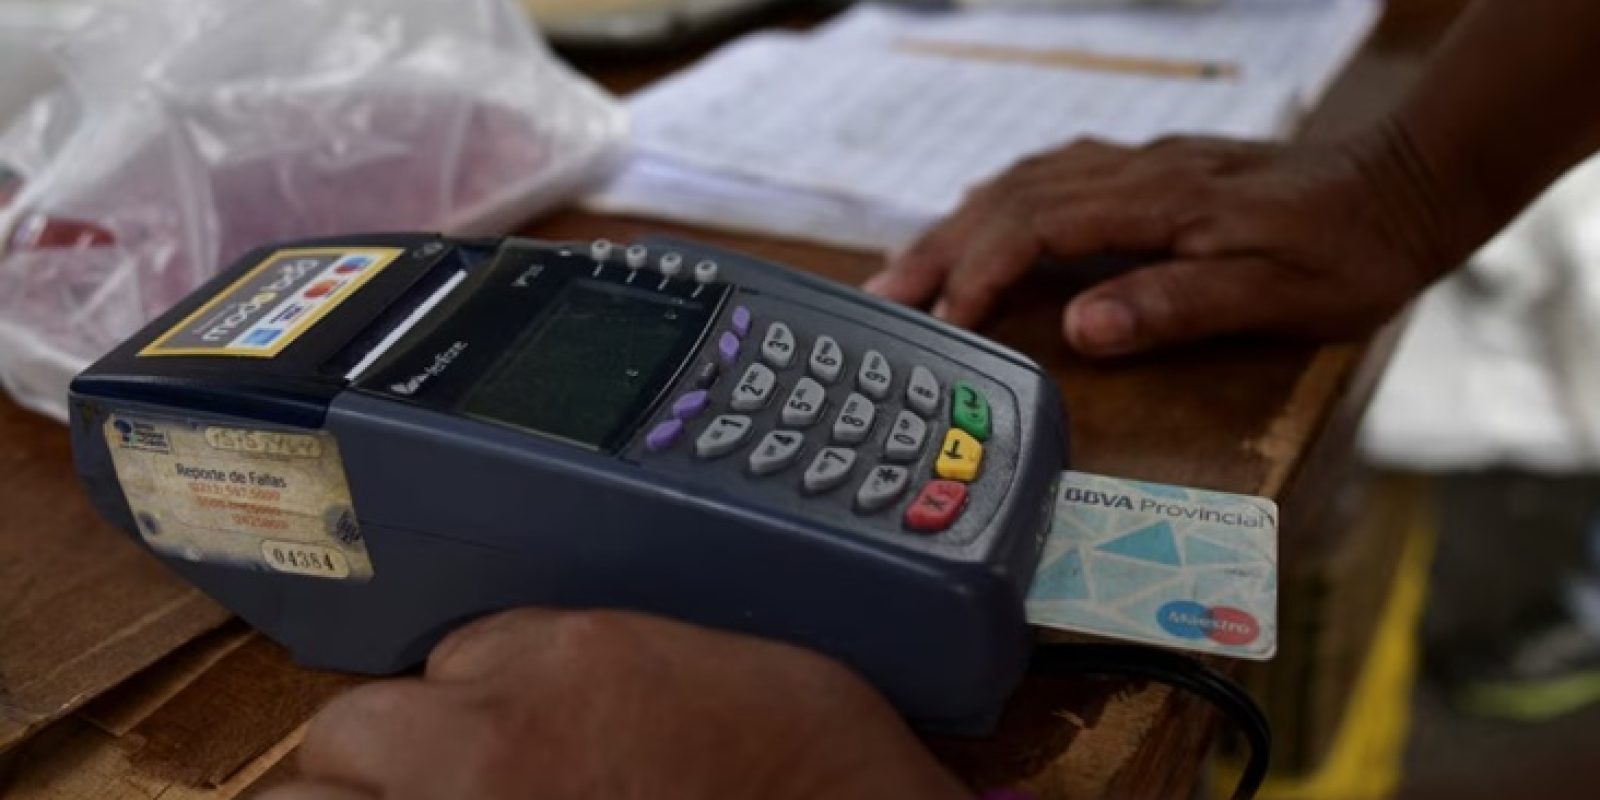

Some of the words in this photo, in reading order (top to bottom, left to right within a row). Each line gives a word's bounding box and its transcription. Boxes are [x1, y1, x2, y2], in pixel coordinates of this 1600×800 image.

[176, 463, 226, 482] Reporte
[229, 470, 246, 484] de
[1063, 487, 1134, 511] BBVA
[1139, 498, 1265, 528] Provincial
[1167, 612, 1251, 634] Maestro
